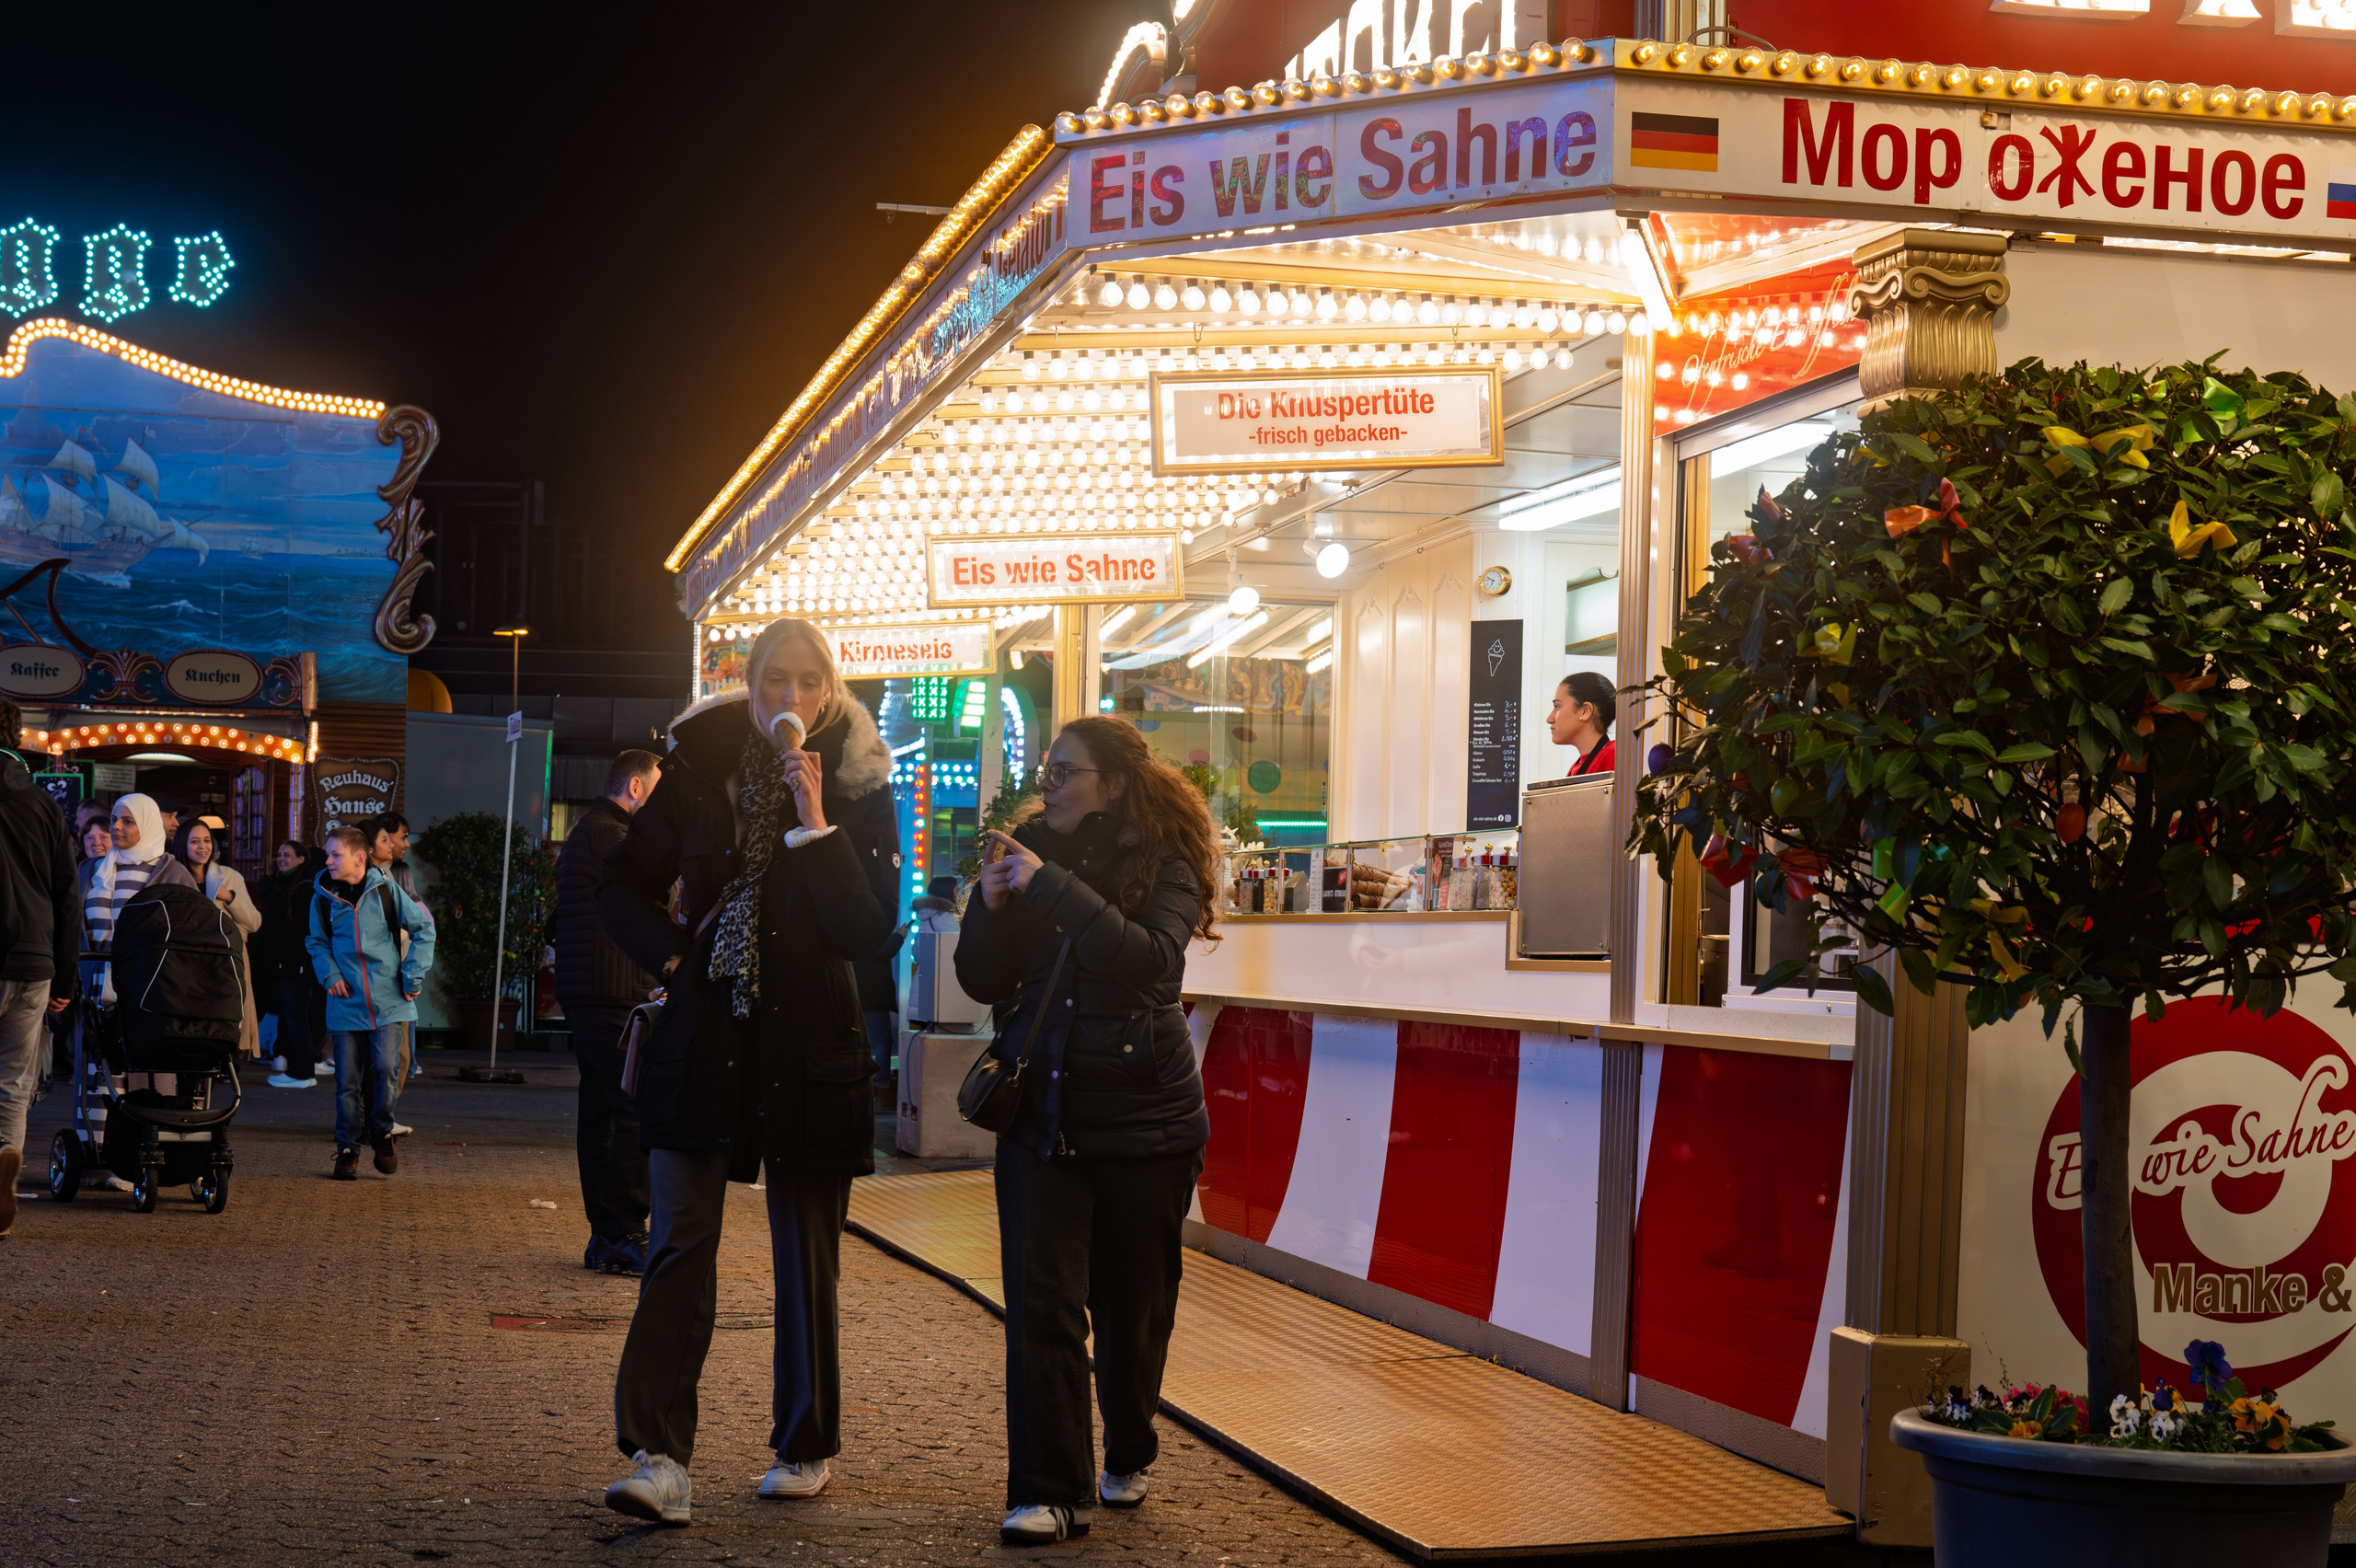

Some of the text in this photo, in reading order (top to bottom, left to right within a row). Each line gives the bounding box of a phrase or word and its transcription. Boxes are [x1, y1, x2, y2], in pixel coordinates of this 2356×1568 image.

[1089, 107, 1597, 234] Eis wie Sahne
[1218, 388, 1436, 421] Die Knuspertüte
[1248, 423, 1408, 447] -frisch gebacken-
[953, 554, 1156, 585] Eis wie Sahne
[839, 638, 953, 663] Kirmeseis
[10, 661, 60, 680] Kaffee
[185, 667, 241, 686] Kuchen
[324, 795, 386, 818] Hanse
[2141, 1129, 2217, 1185] wie
[2226, 1064, 2355, 1170] Sahne
[2153, 1263, 2353, 1314] Manke &
